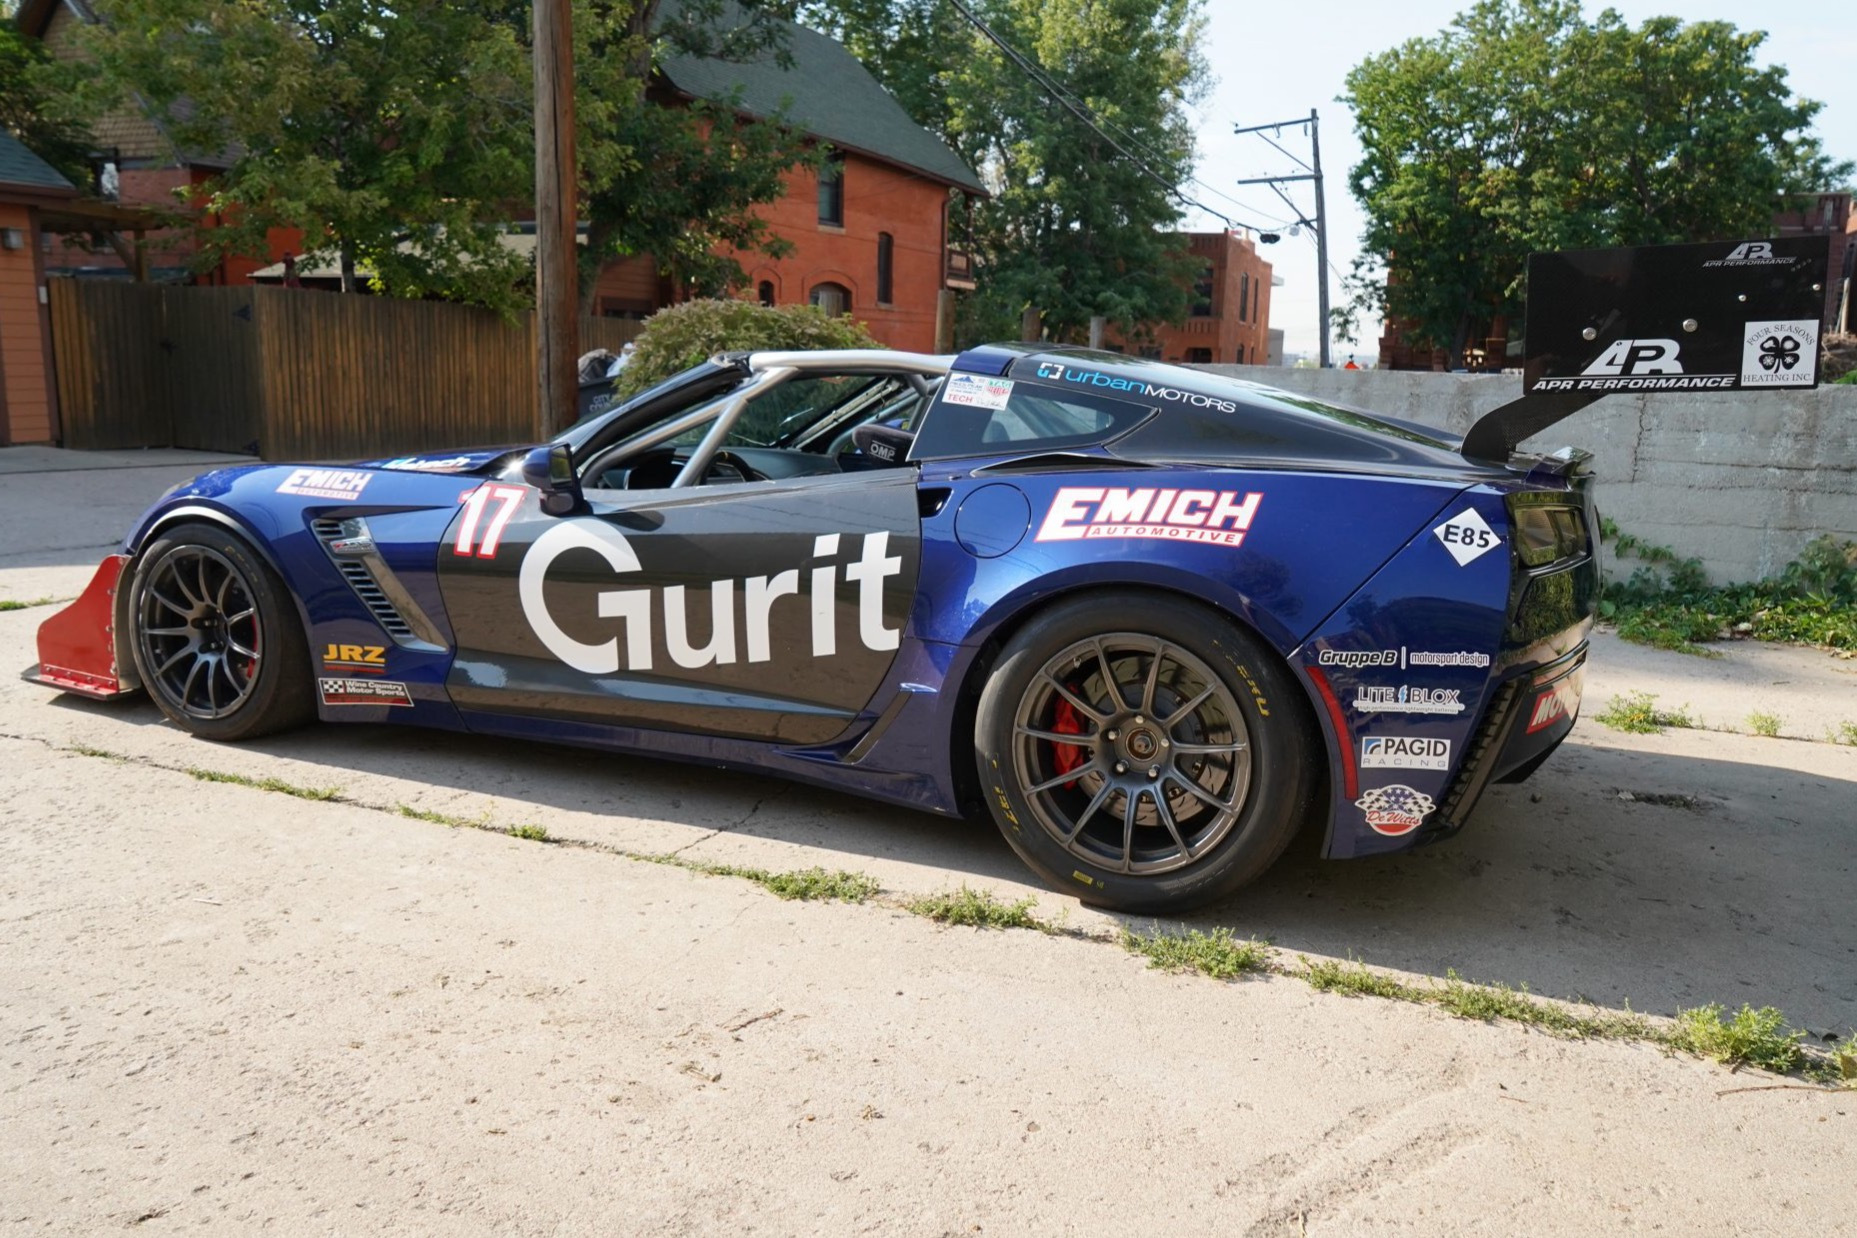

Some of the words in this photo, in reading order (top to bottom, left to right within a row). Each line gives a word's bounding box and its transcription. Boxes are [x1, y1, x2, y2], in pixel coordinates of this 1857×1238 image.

[1702, 260, 1722, 268] APR
[1723, 258, 1796, 267] PERFORMANCE
[1747, 327, 1772, 346] FOUR
[1774, 324, 1815, 346] SEASONS
[1532, 379, 1574, 391] APR
[1577, 377, 1736, 390] PERFORMANCE
[1743, 374, 1789, 382] HEATING
[948, 393, 974, 403] TECH
[870, 443, 896, 459] OMP
[275, 469, 375, 493] EMICH
[453, 483, 529, 560] 17
[1034, 486, 1264, 542] EMICH
[1091, 526, 1236, 544] AUTOMOTIVE
[1443, 524, 1490, 548] E85
[519, 518, 902, 674] Gurit
[323, 644, 385, 663] JRZ
[1319, 650, 1380, 667] Gruppe
[1381, 650, 1398, 666] B
[1410, 652, 1458, 666] motorsport
[1459, 651, 1490, 667] design
[344, 680, 367, 688] Wine
[368, 682, 403, 691] Country
[346, 686, 374, 694] Motor
[375, 688, 405, 697] Sports
[1358, 686, 1395, 703] LITE
[1410, 687, 1461, 705] BLOX
[1384, 738, 1447, 757] PAGID
[1363, 758, 1446, 768] RACING
